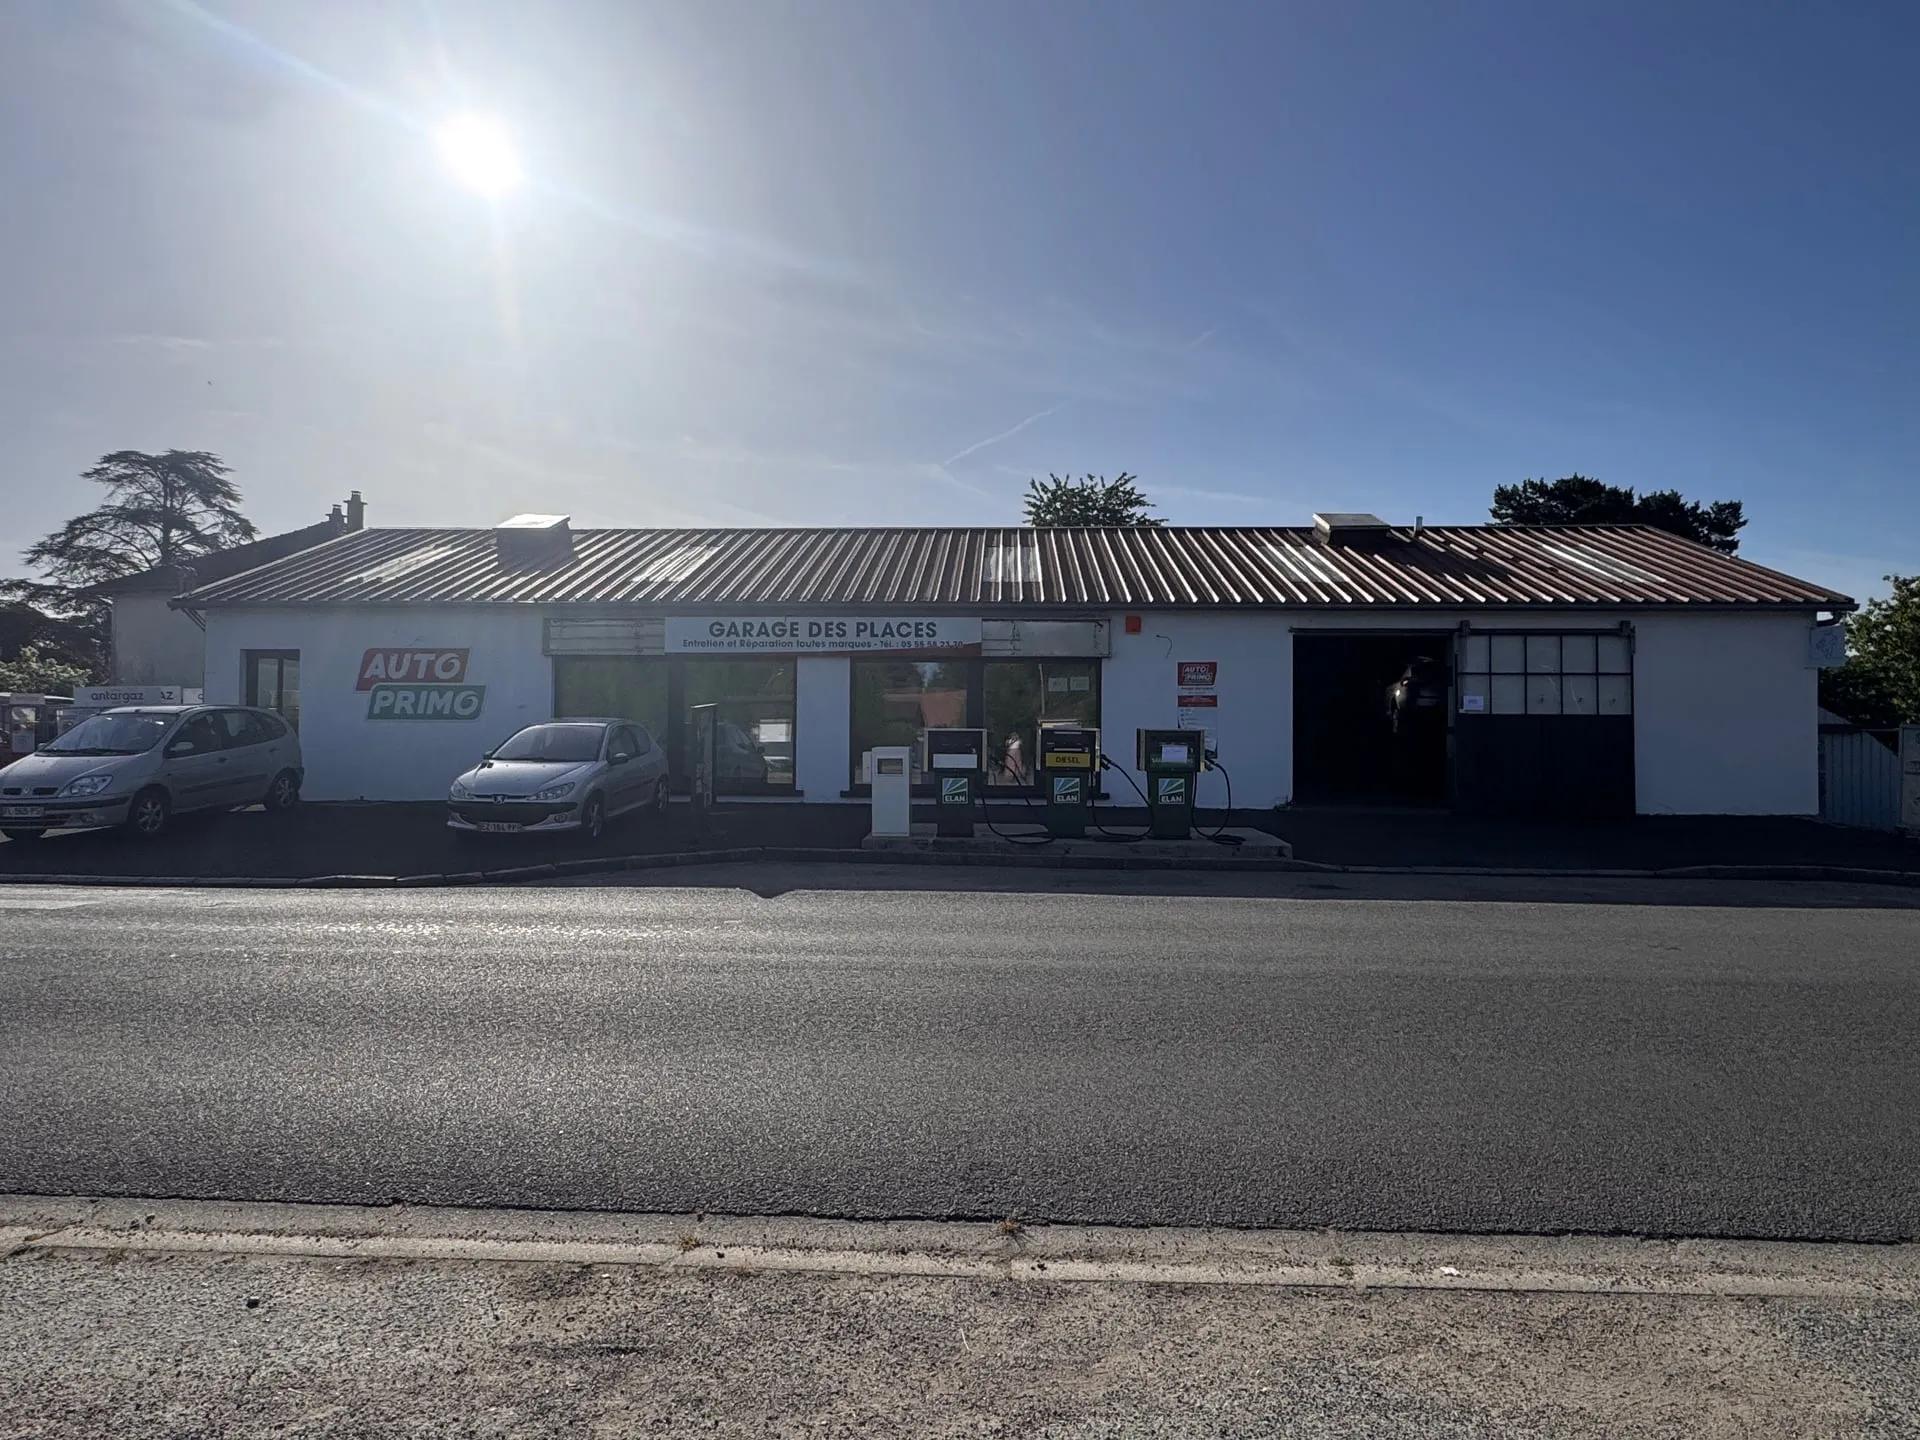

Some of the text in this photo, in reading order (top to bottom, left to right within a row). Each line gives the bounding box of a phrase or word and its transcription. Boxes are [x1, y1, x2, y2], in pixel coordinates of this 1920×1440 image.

[709, 621, 937, 638] GARAGE DES PLACES
[682, 639, 724, 648] Entretien
[727, 639, 737, 648] et
[740, 639, 793, 650] Réparation
[796, 639, 826, 648] toutes
[828, 640, 872, 650] marques
[363, 652, 461, 680] AUTO
[91, 690, 144, 703] antargaz
[373, 690, 479, 716] PRIMO
[1055, 756, 1081, 764] DIESEL
